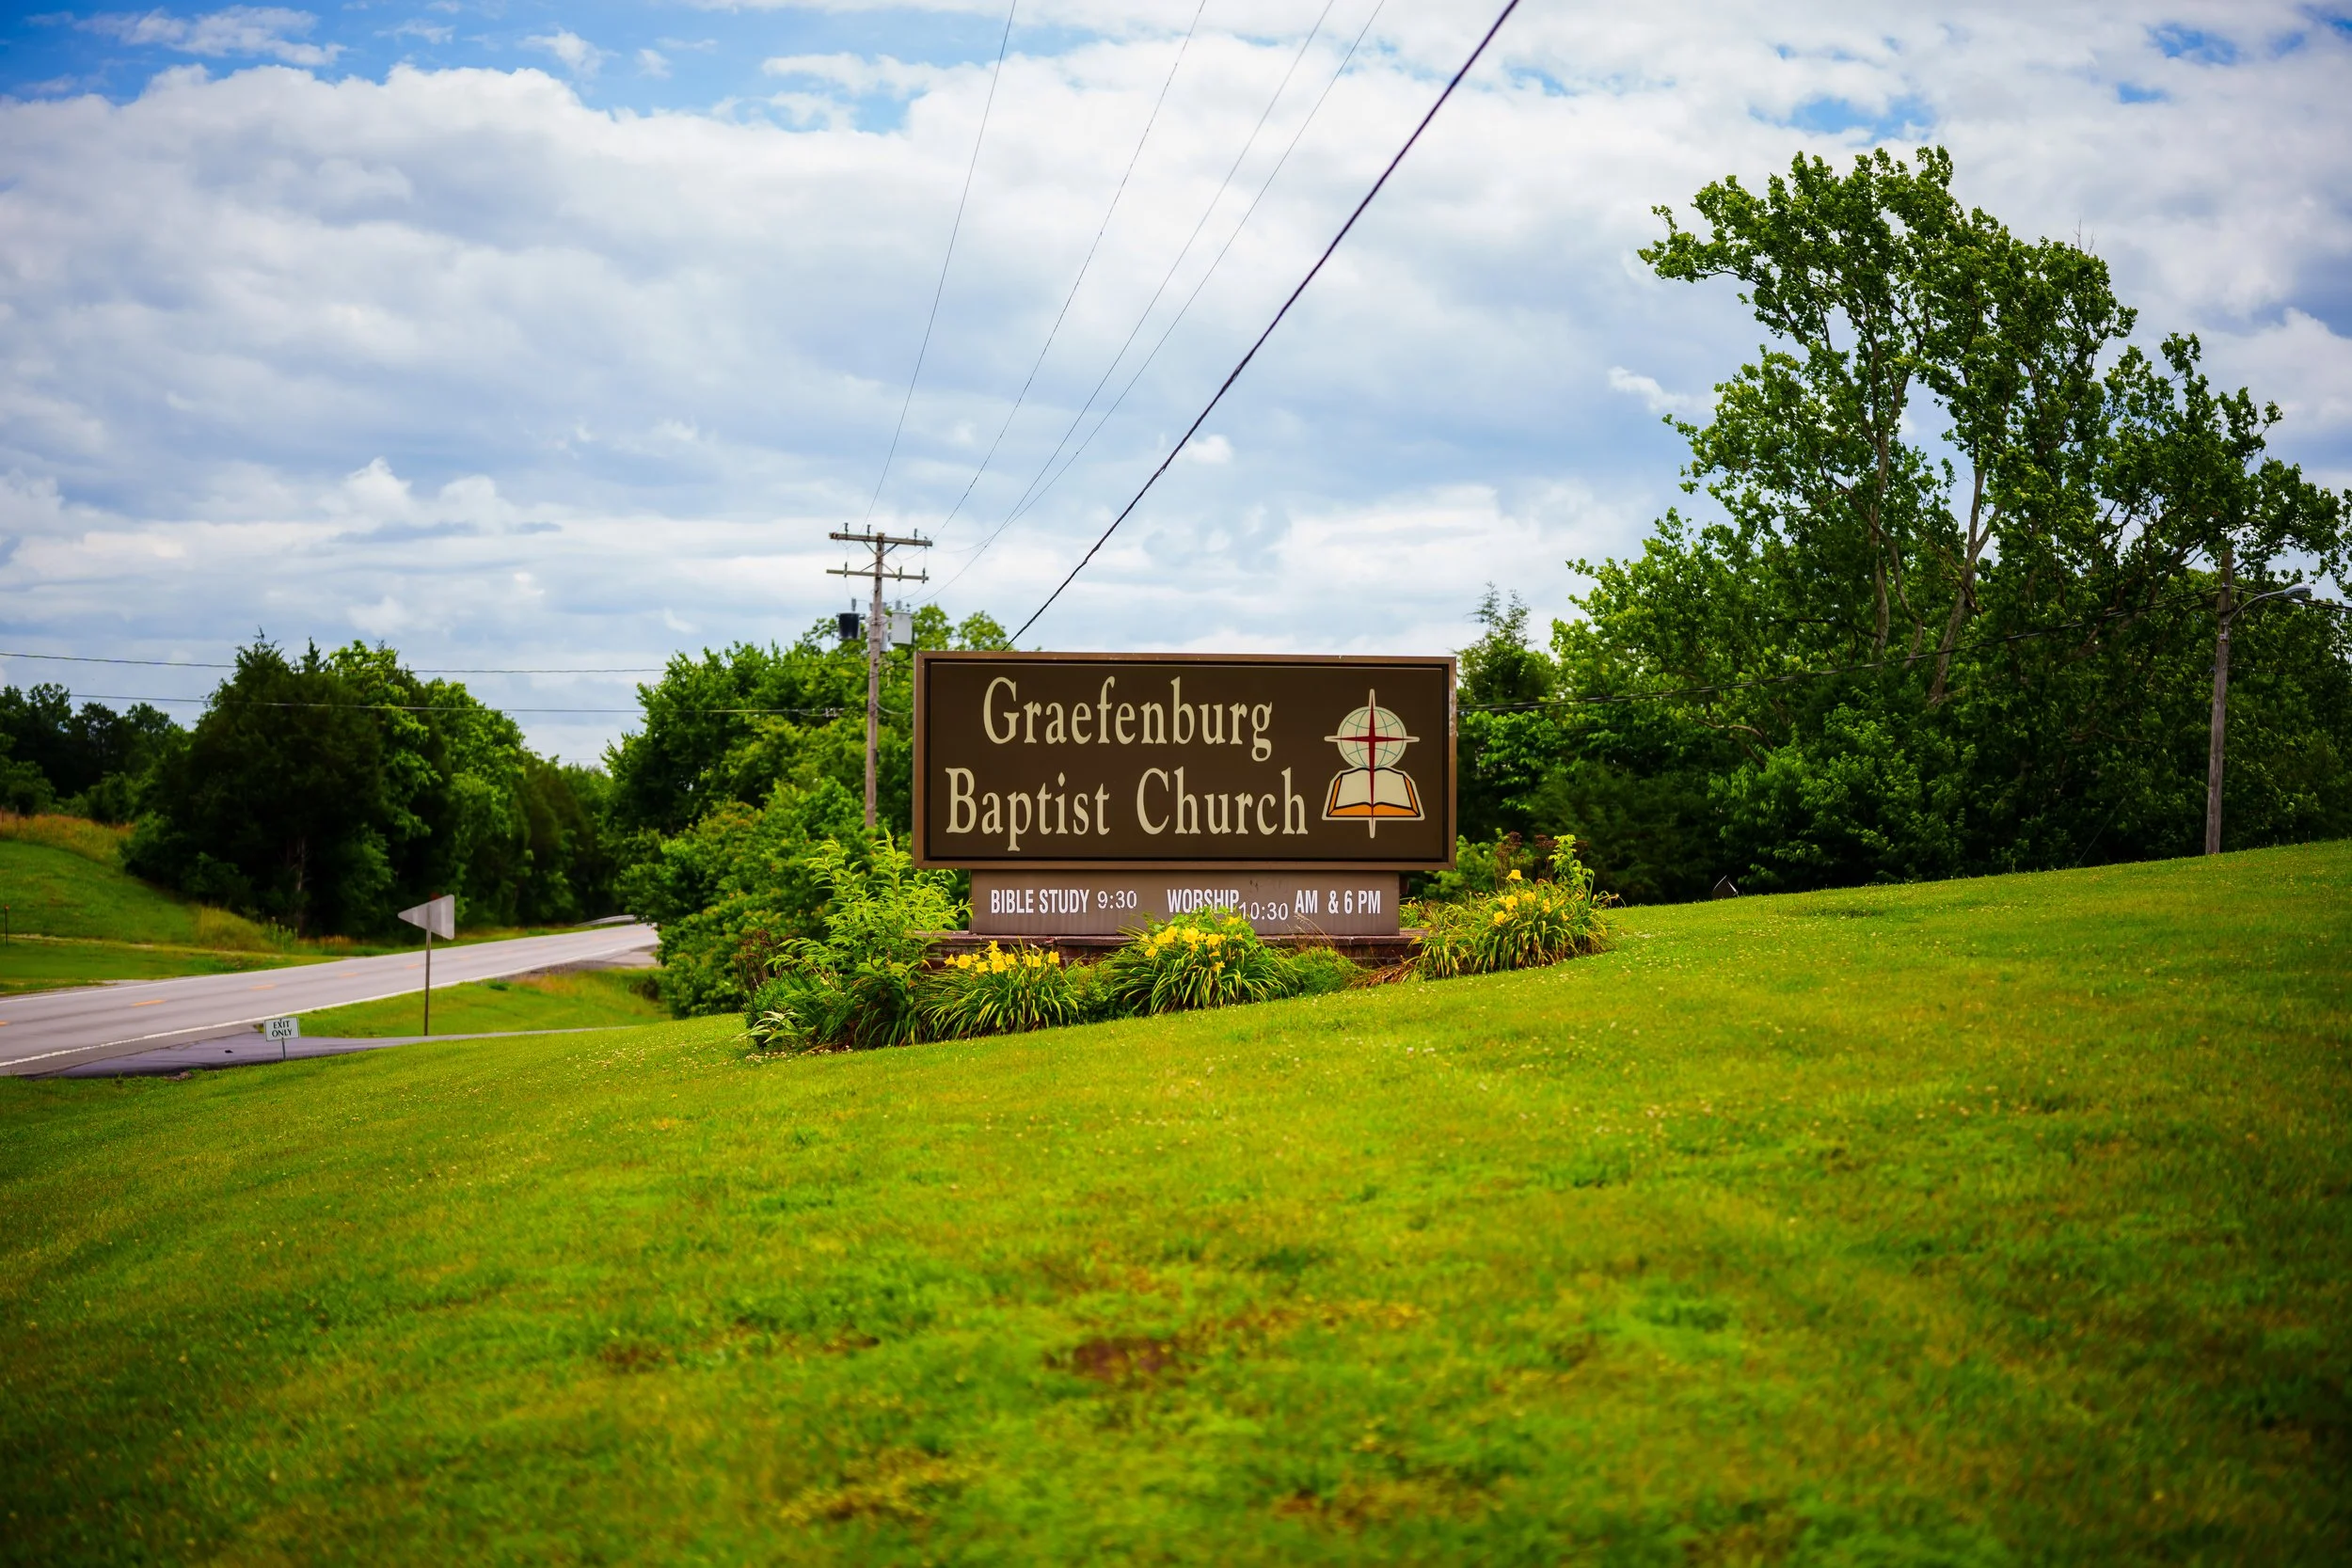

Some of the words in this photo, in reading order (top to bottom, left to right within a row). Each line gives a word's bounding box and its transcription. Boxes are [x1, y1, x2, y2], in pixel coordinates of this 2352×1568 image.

[983, 675, 1273, 762] Graefenburg
[946, 768, 1110, 852] Baptist
[1136, 767, 1309, 835] Church
[991, 889, 1034, 914] BIBLE
[1039, 889, 1089, 914] STUDY
[1097, 890, 1137, 910] 9:30
[1167, 888, 1240, 913] WORSHIP
[1238, 901, 1289, 921] 10:30
[1294, 889, 1318, 914] AM
[1327, 890, 1339, 914] &
[1343, 890, 1353, 914] 6
[1358, 890, 1381, 914] PM
[271, 1028, 293, 1037] ONLY
[273, 1020, 290, 1029] EXIT
